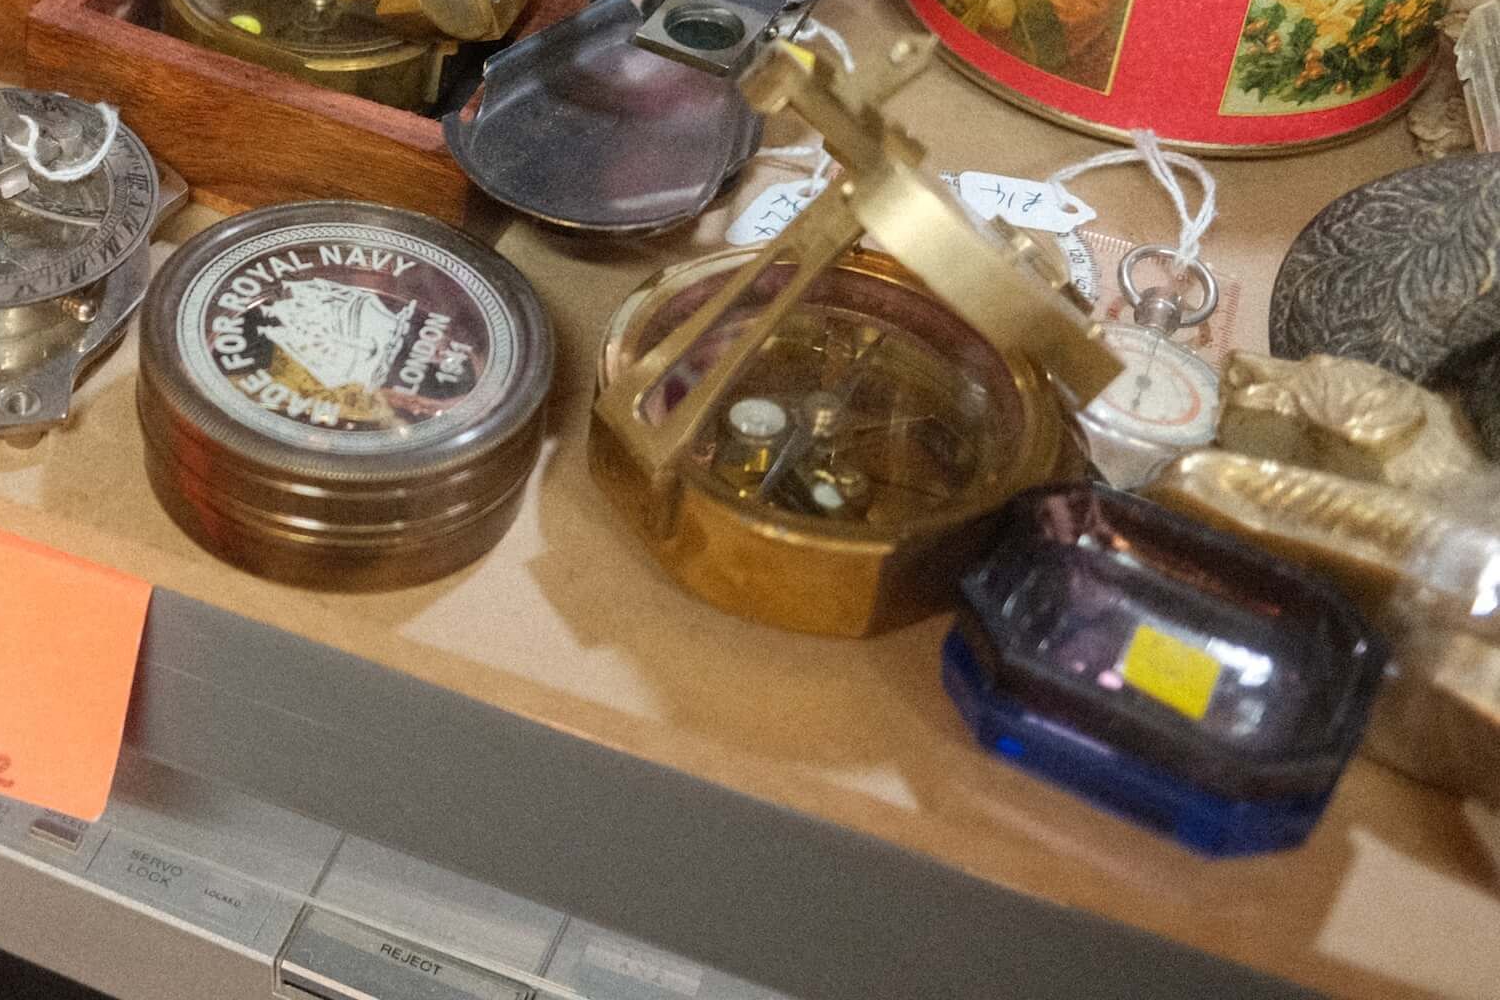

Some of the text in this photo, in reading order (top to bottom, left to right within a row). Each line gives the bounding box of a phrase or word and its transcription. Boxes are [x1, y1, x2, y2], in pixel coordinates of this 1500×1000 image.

[211, 244, 417, 428] MADE FOR ROYAL NAVY
[393, 311, 451, 398] LONDON
[126, 863, 173, 888] LOCK
[129, 849, 183, 878] SERVO
[204, 887, 242, 909] LOCKED
[380, 941, 444, 977] REJECT
